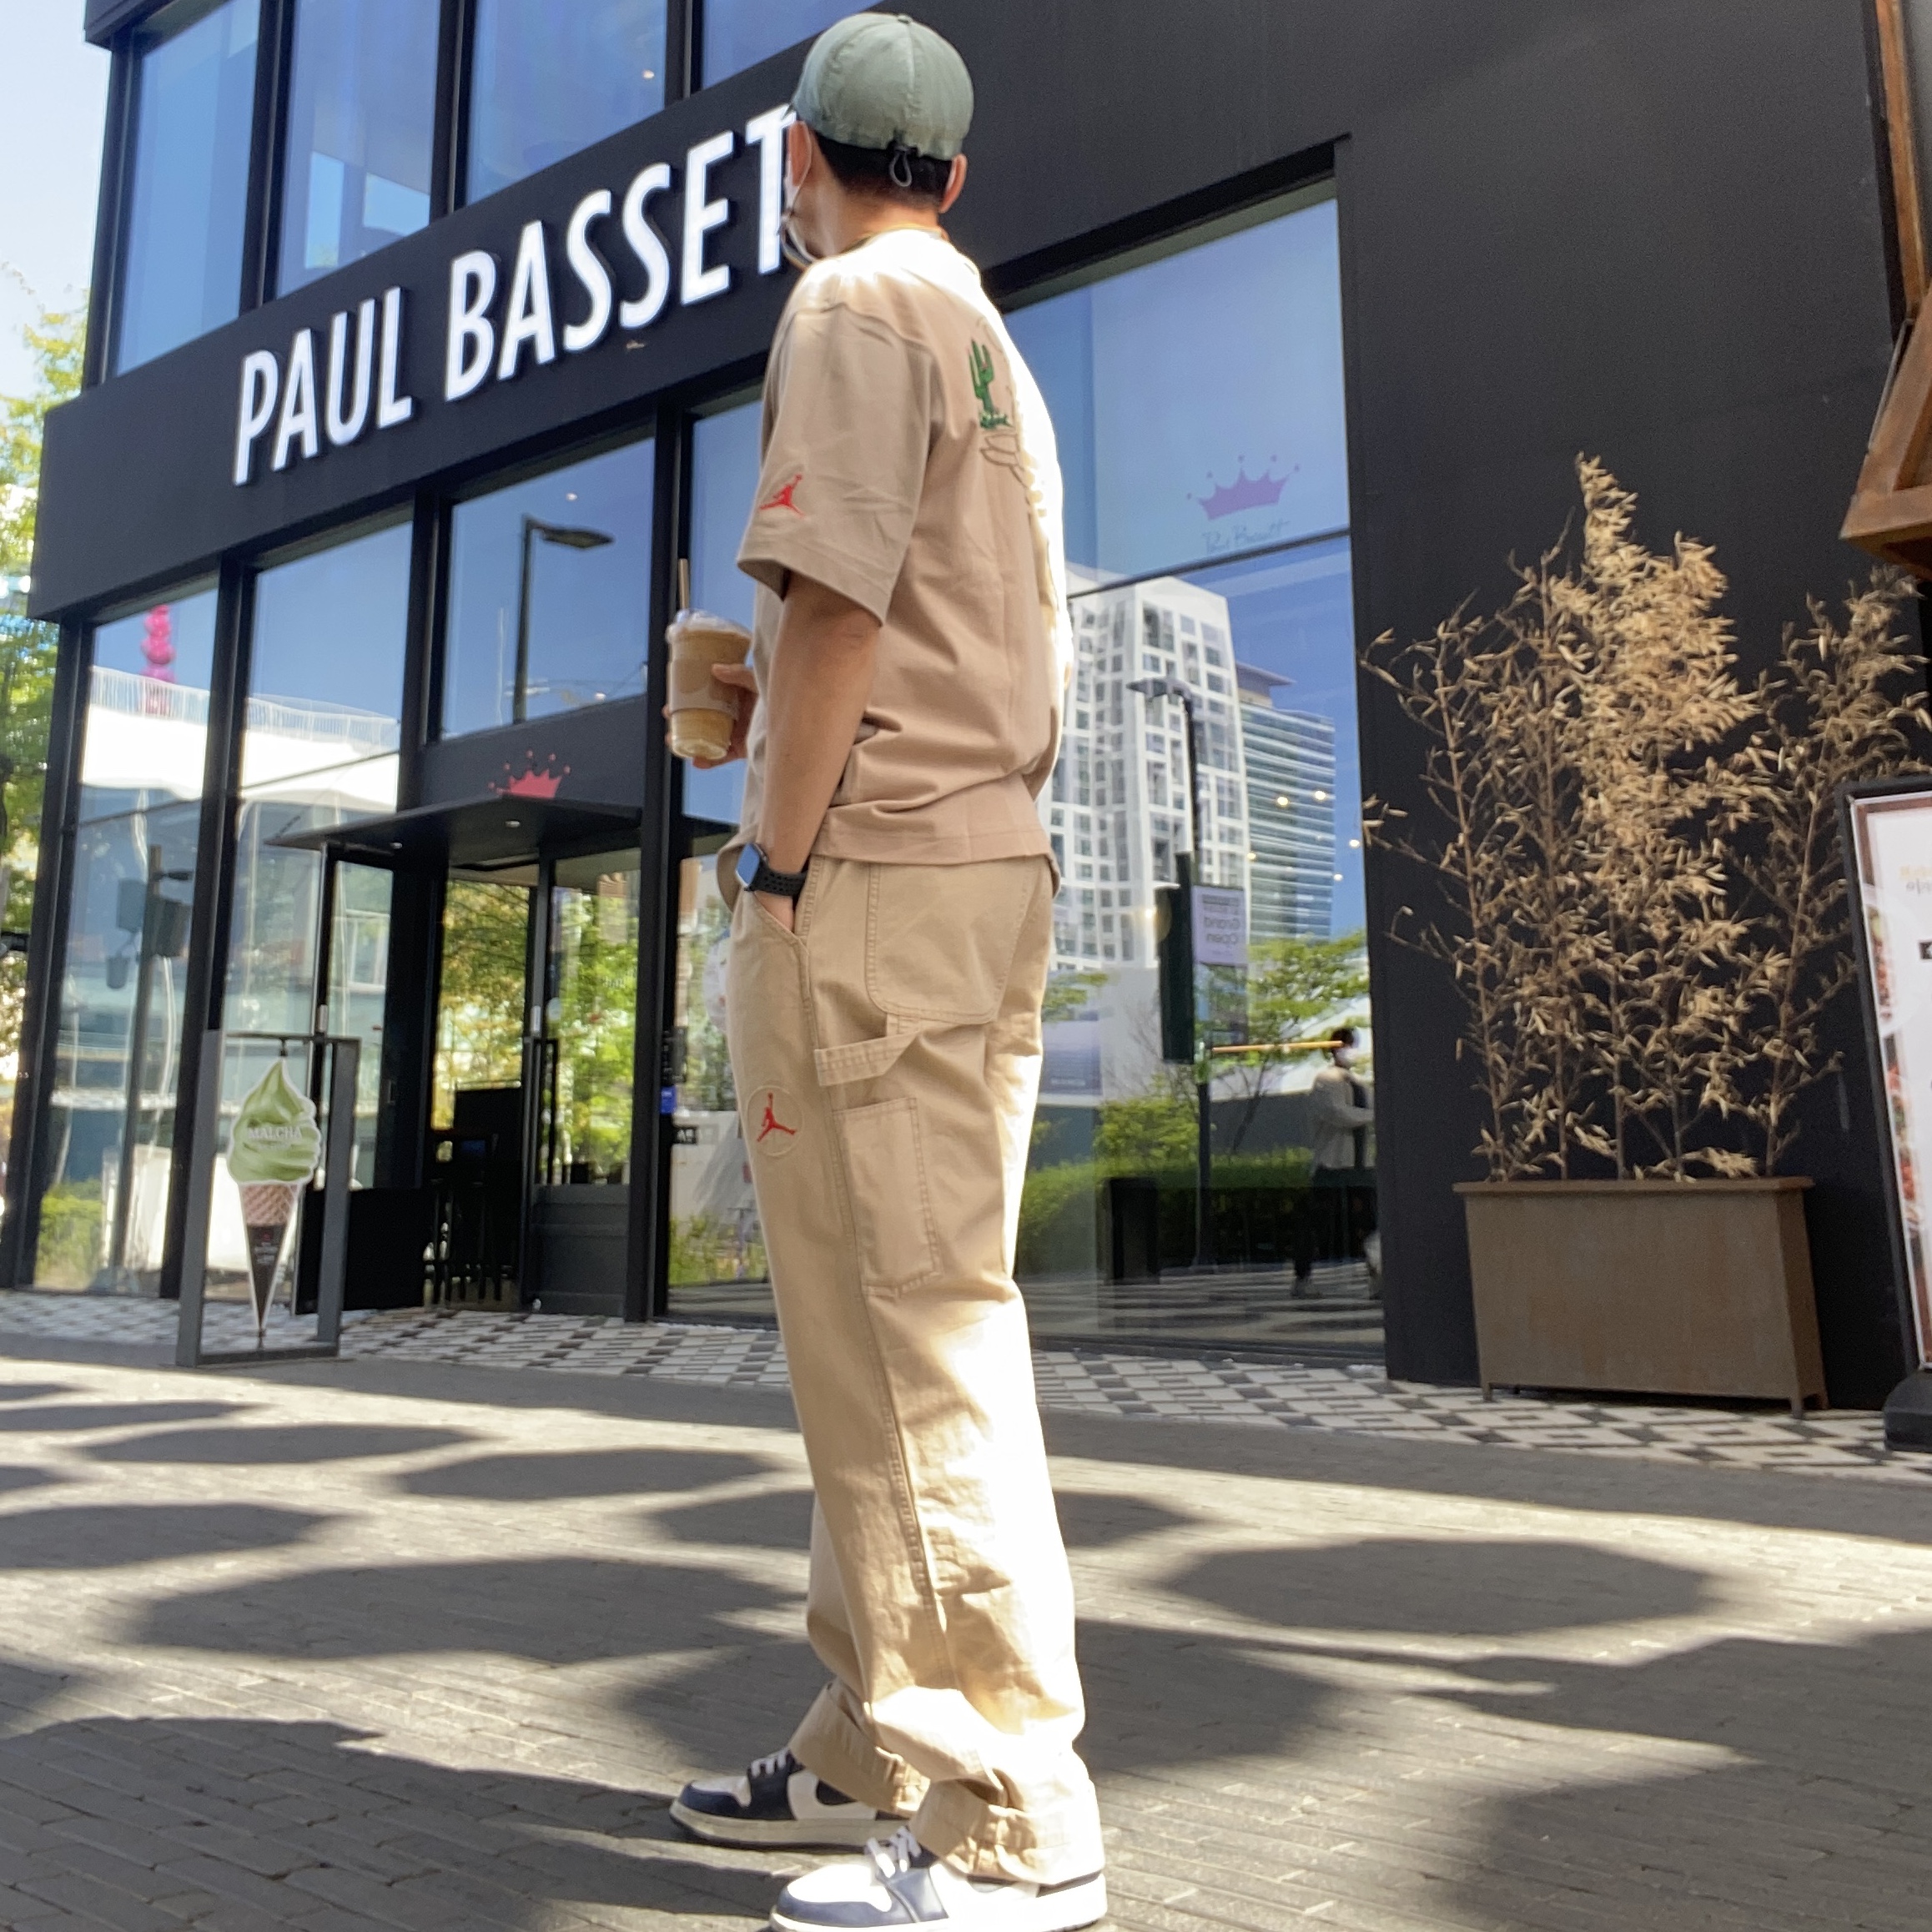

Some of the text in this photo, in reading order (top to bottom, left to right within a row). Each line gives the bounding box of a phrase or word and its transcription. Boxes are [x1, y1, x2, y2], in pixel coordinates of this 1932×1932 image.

[233, 103, 797, 486] PAUL BASSET
[248, 1125, 303, 1140] MALCHA
